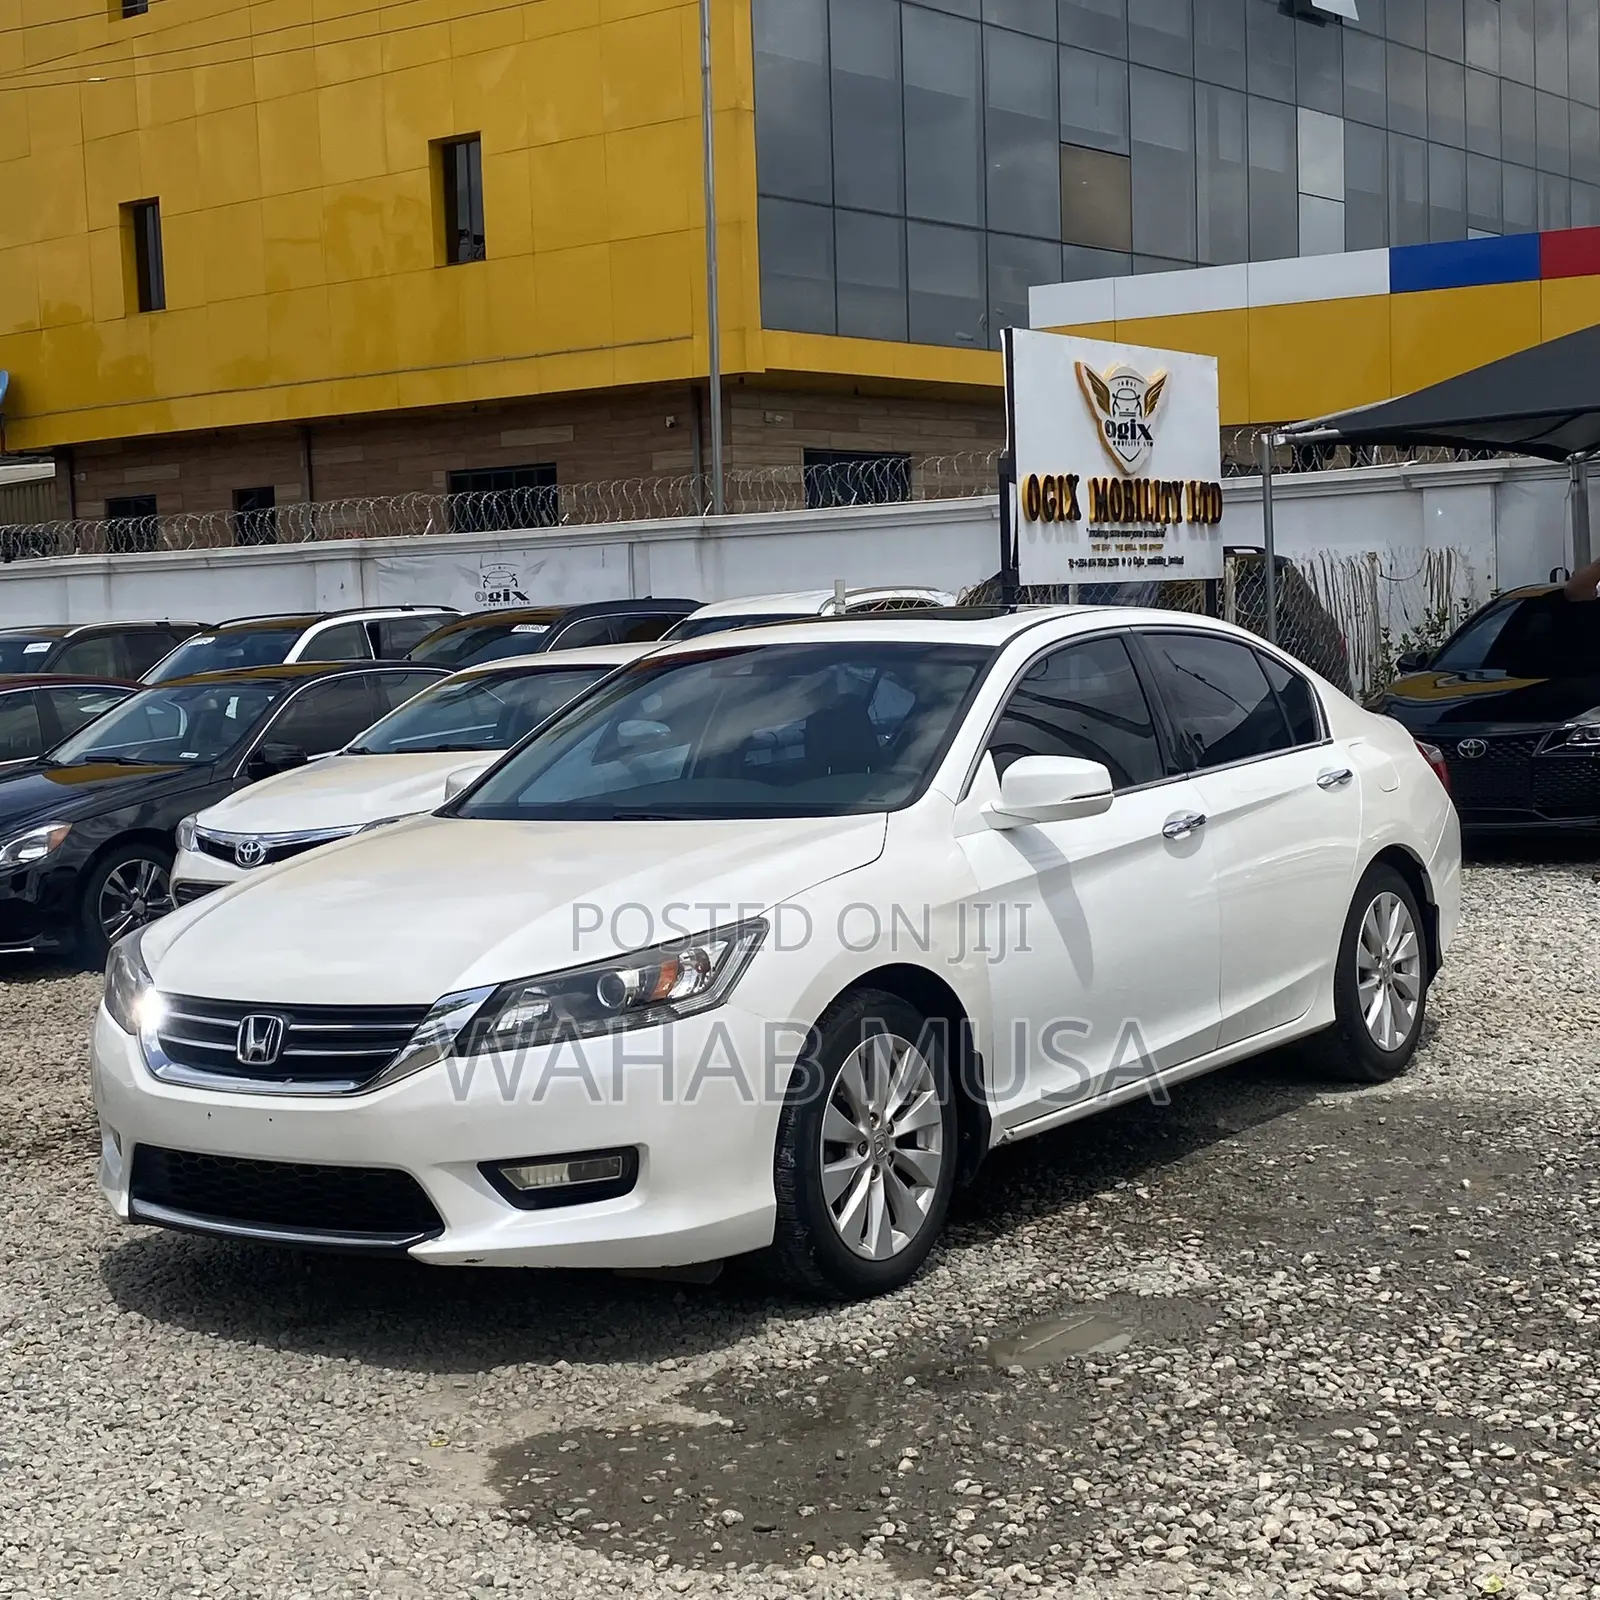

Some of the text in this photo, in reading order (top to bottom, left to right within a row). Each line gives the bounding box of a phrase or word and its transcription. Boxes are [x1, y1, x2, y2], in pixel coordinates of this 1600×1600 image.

[1022, 473, 1223, 524] OGIX MOBILITY LTD
